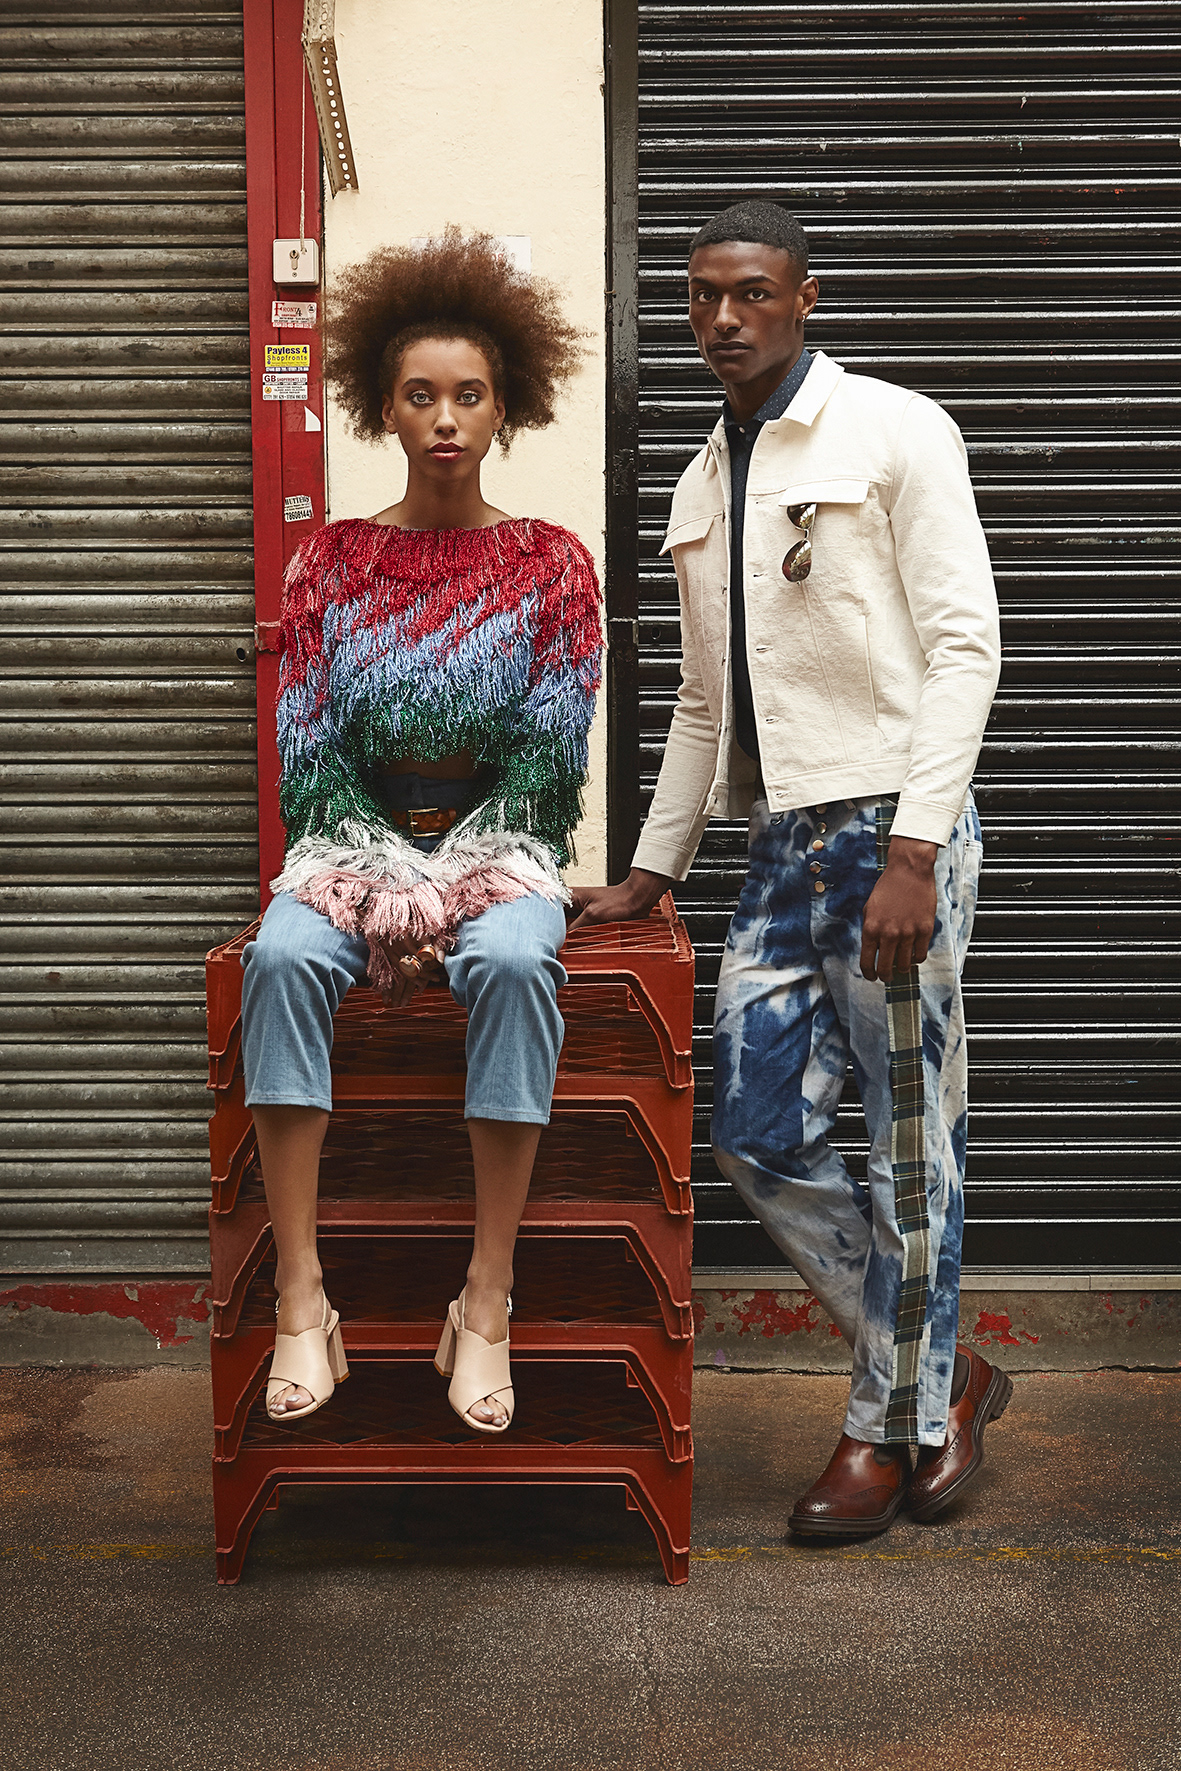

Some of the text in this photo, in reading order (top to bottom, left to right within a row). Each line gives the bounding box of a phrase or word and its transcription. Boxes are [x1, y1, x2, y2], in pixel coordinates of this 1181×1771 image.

[296, 307, 302, 317] 4
[267, 346, 308, 355] Payless 4
